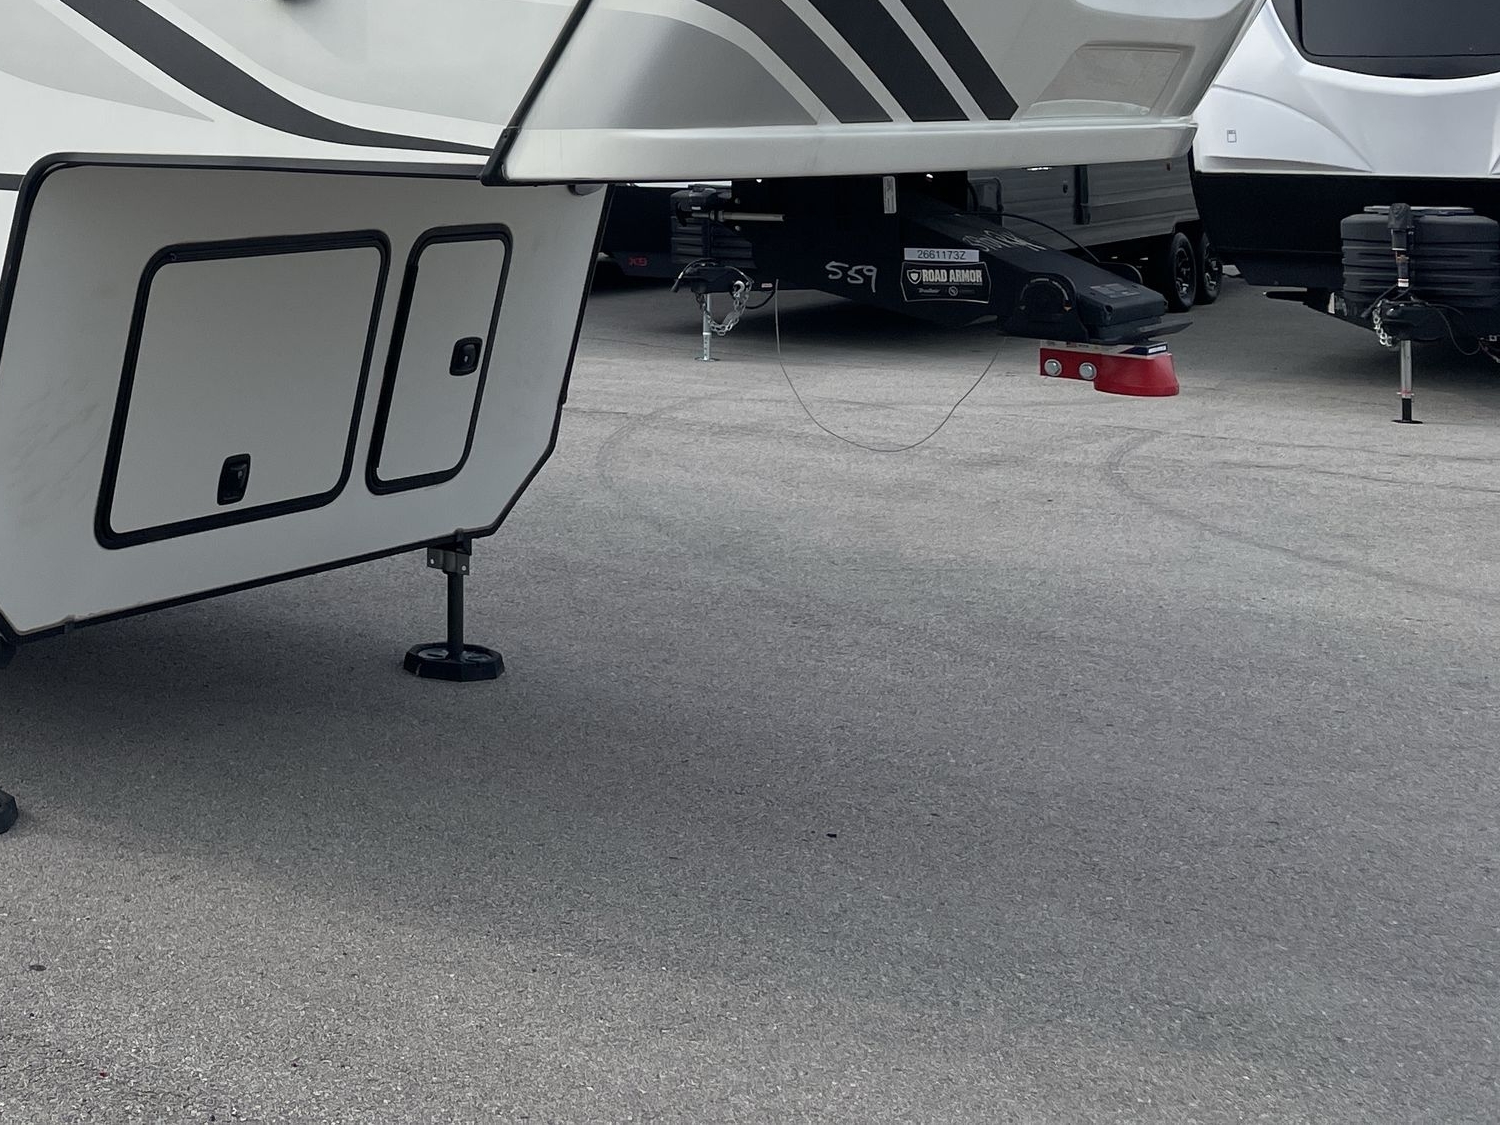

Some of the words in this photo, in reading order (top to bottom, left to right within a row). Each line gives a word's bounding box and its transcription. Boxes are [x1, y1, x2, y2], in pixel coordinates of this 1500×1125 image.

[824, 260, 878, 293] 559
[921, 268, 948, 283] ROAD
[949, 269, 983, 283] ARMOR
